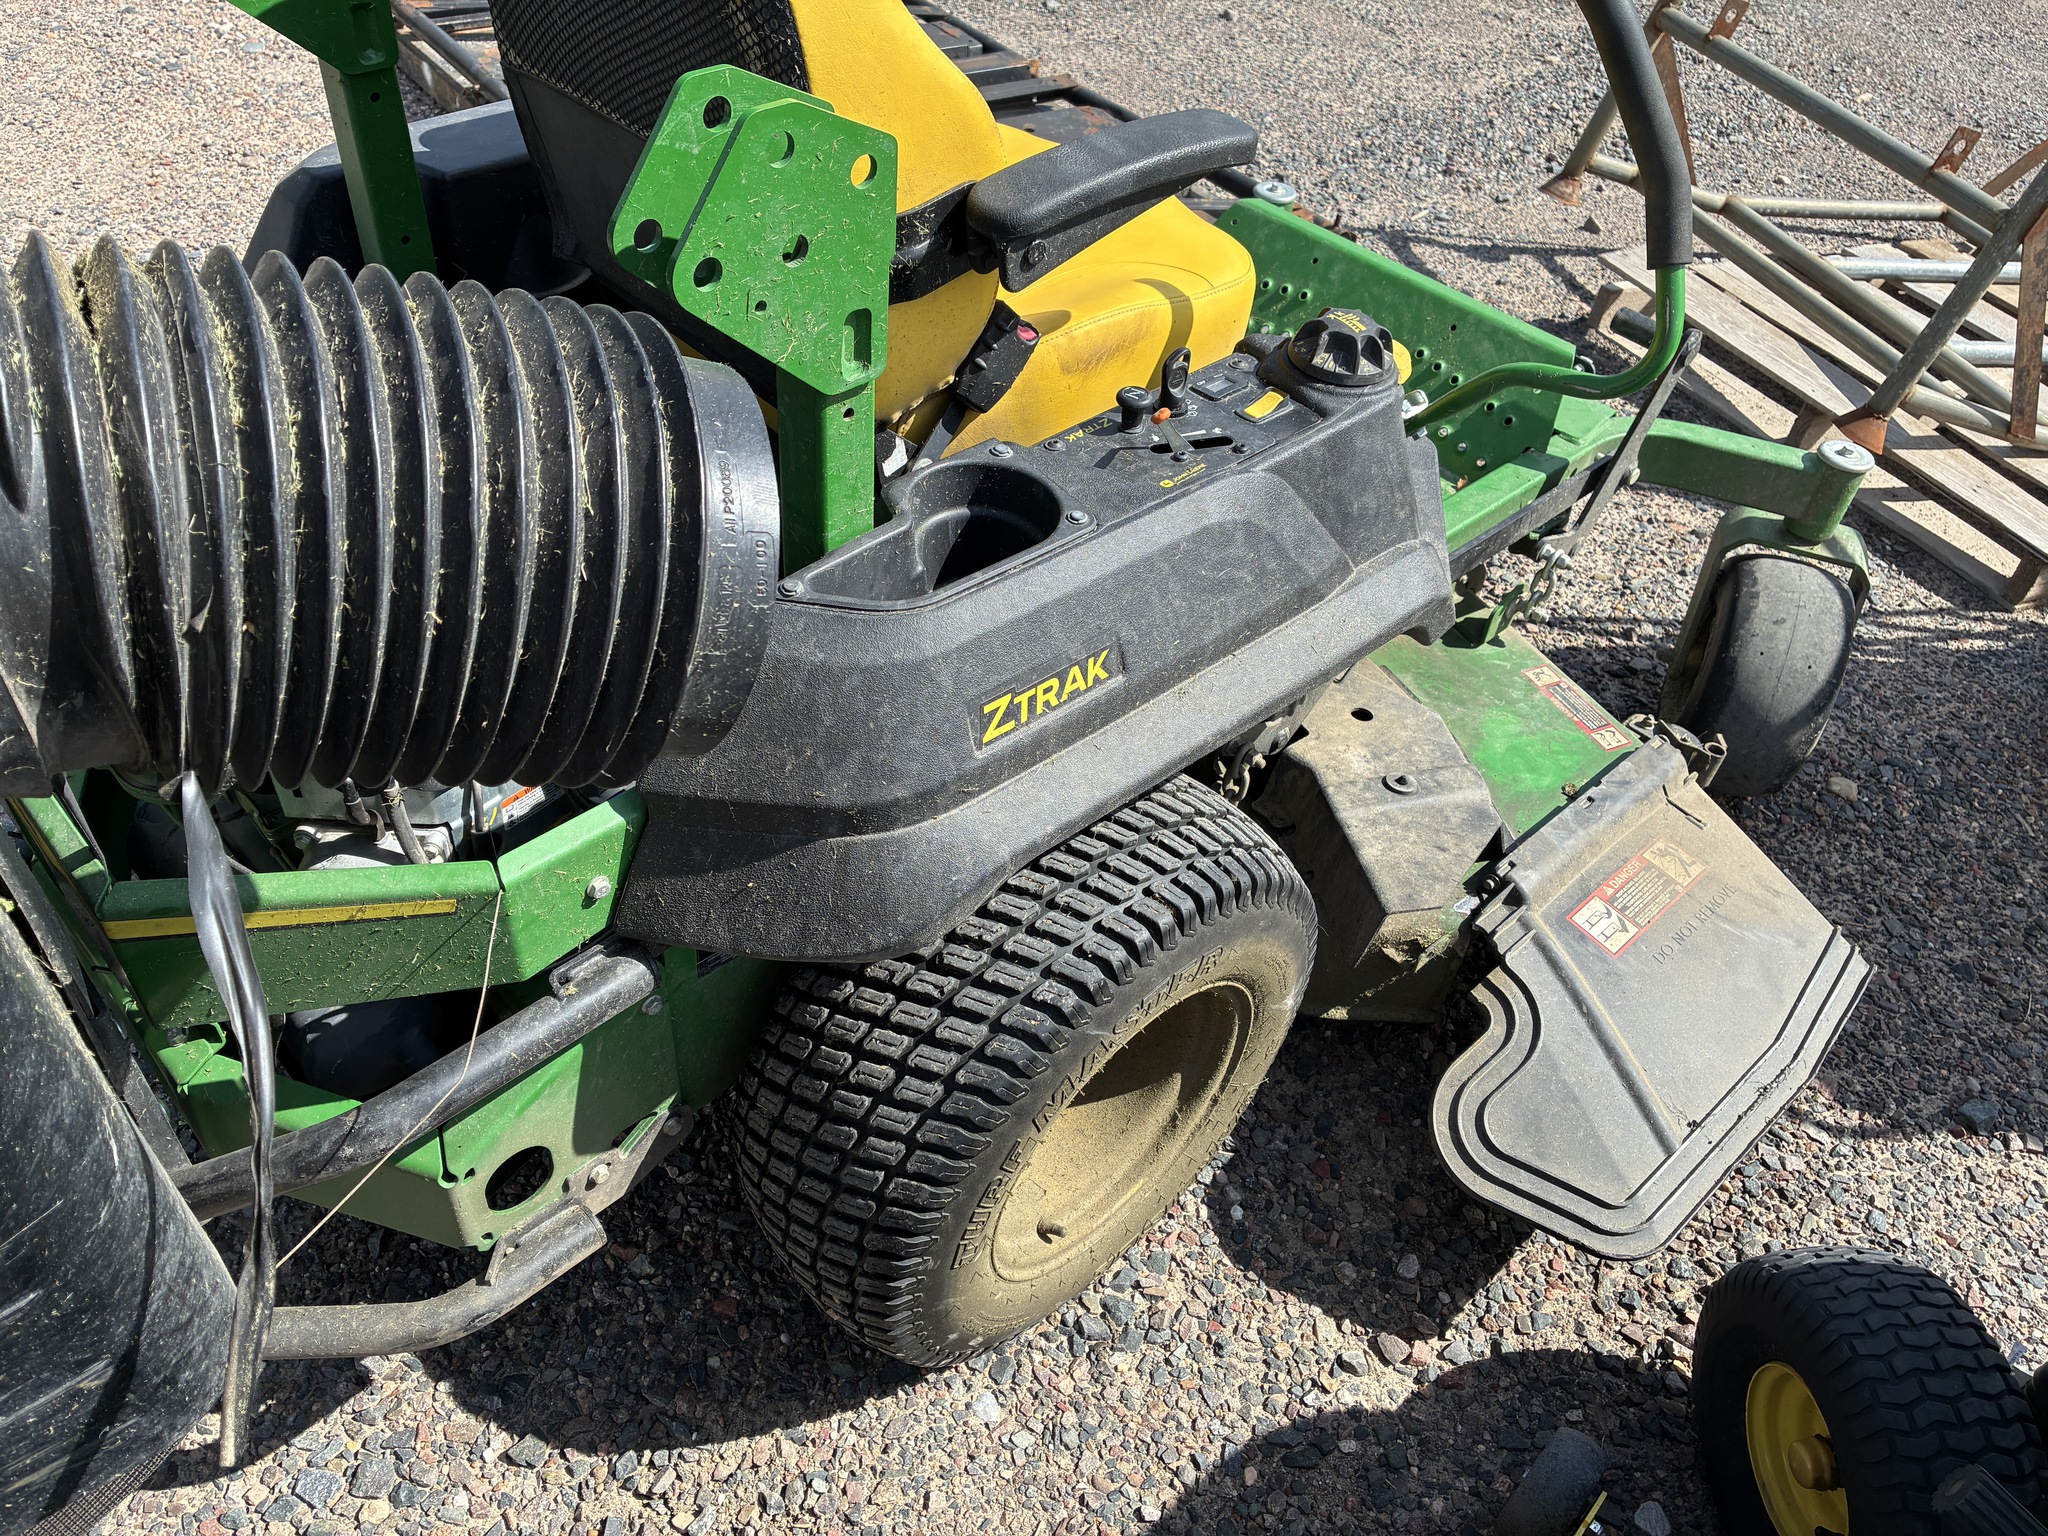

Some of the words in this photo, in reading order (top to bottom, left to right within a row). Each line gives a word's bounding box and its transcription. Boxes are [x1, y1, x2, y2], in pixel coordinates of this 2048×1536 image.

[1064, 417, 1113, 443] ZTRAK
[983, 649, 1109, 744] ZTRAK
[1609, 860, 1643, 890] DANGER
[1652, 943, 1674, 965] DO
[1671, 921, 1698, 946] NOT
[1695, 882, 1738, 925] REMOVE
